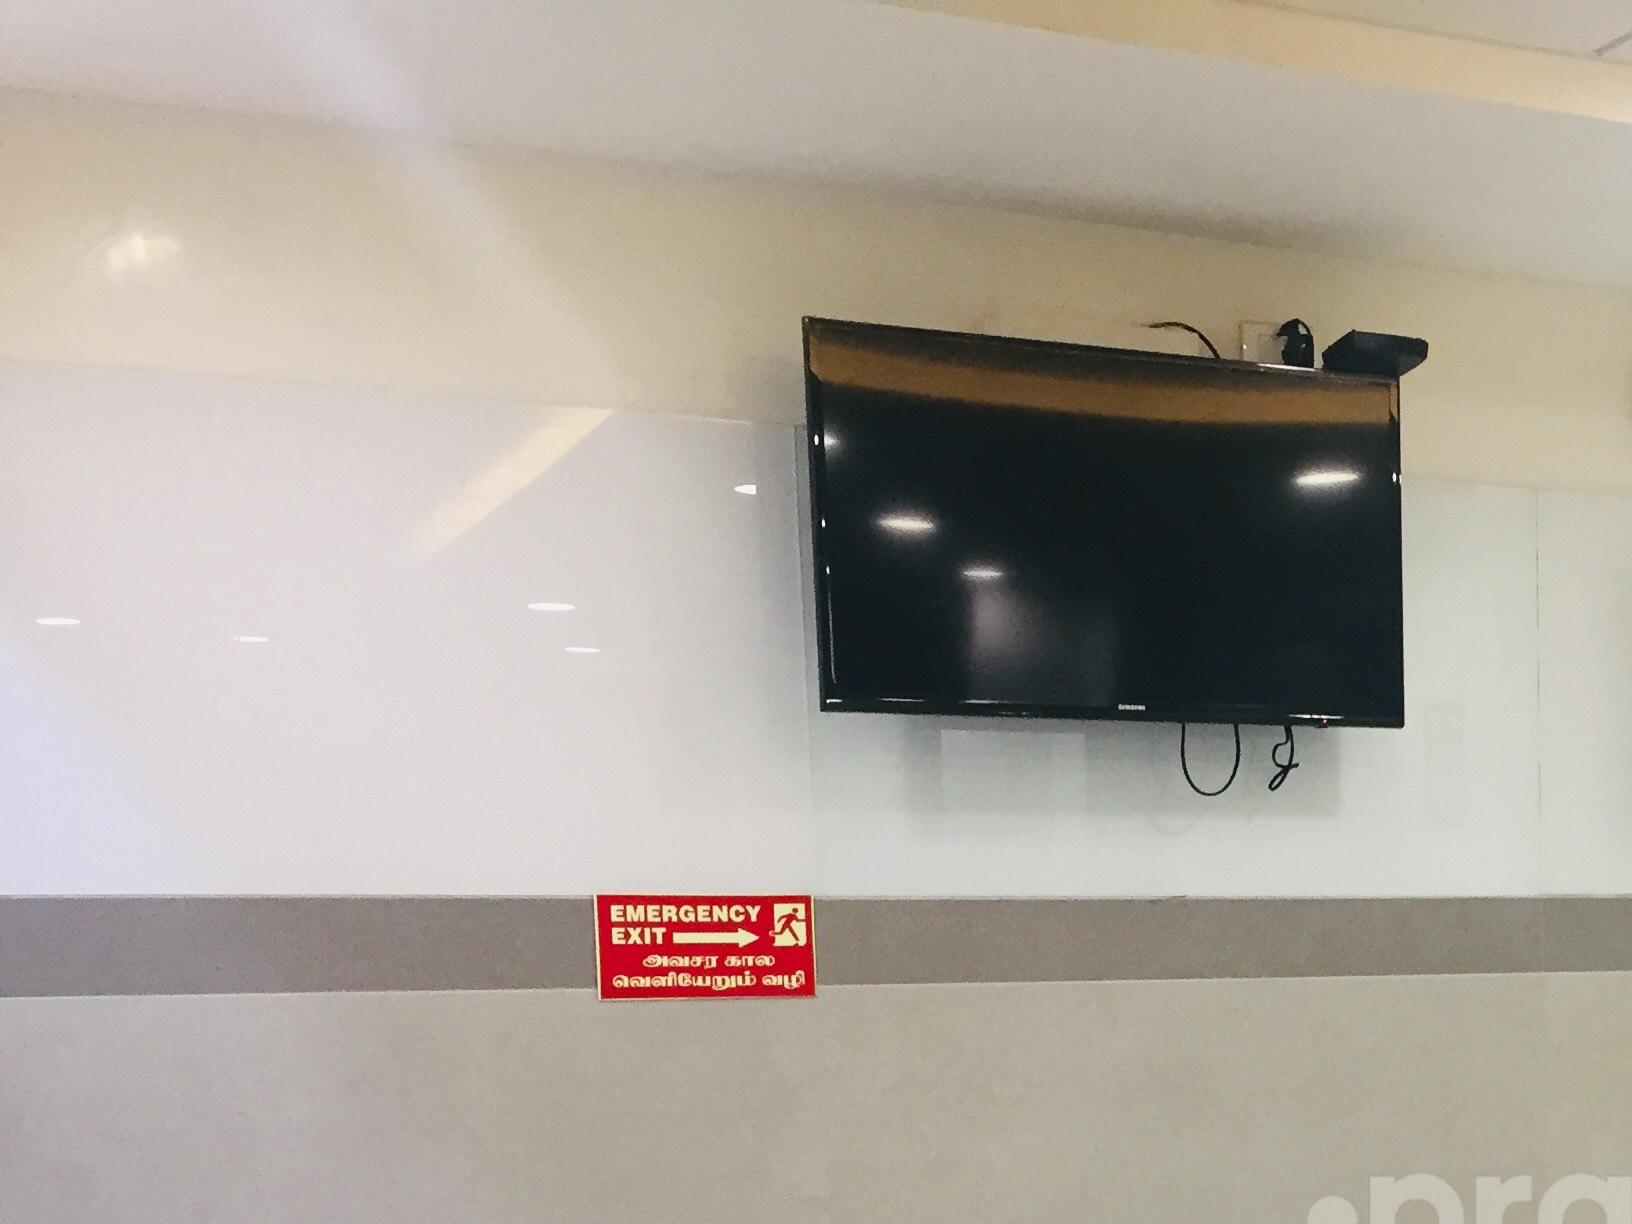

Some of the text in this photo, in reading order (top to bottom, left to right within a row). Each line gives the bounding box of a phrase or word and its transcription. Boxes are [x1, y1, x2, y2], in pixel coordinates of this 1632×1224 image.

[610, 903, 761, 923] EMERGENCY
[611, 927, 667, 945] EXIT
[642, 954, 776, 970] அவசர கால
[612, 970, 806, 991] வெளியேறும் வழி
